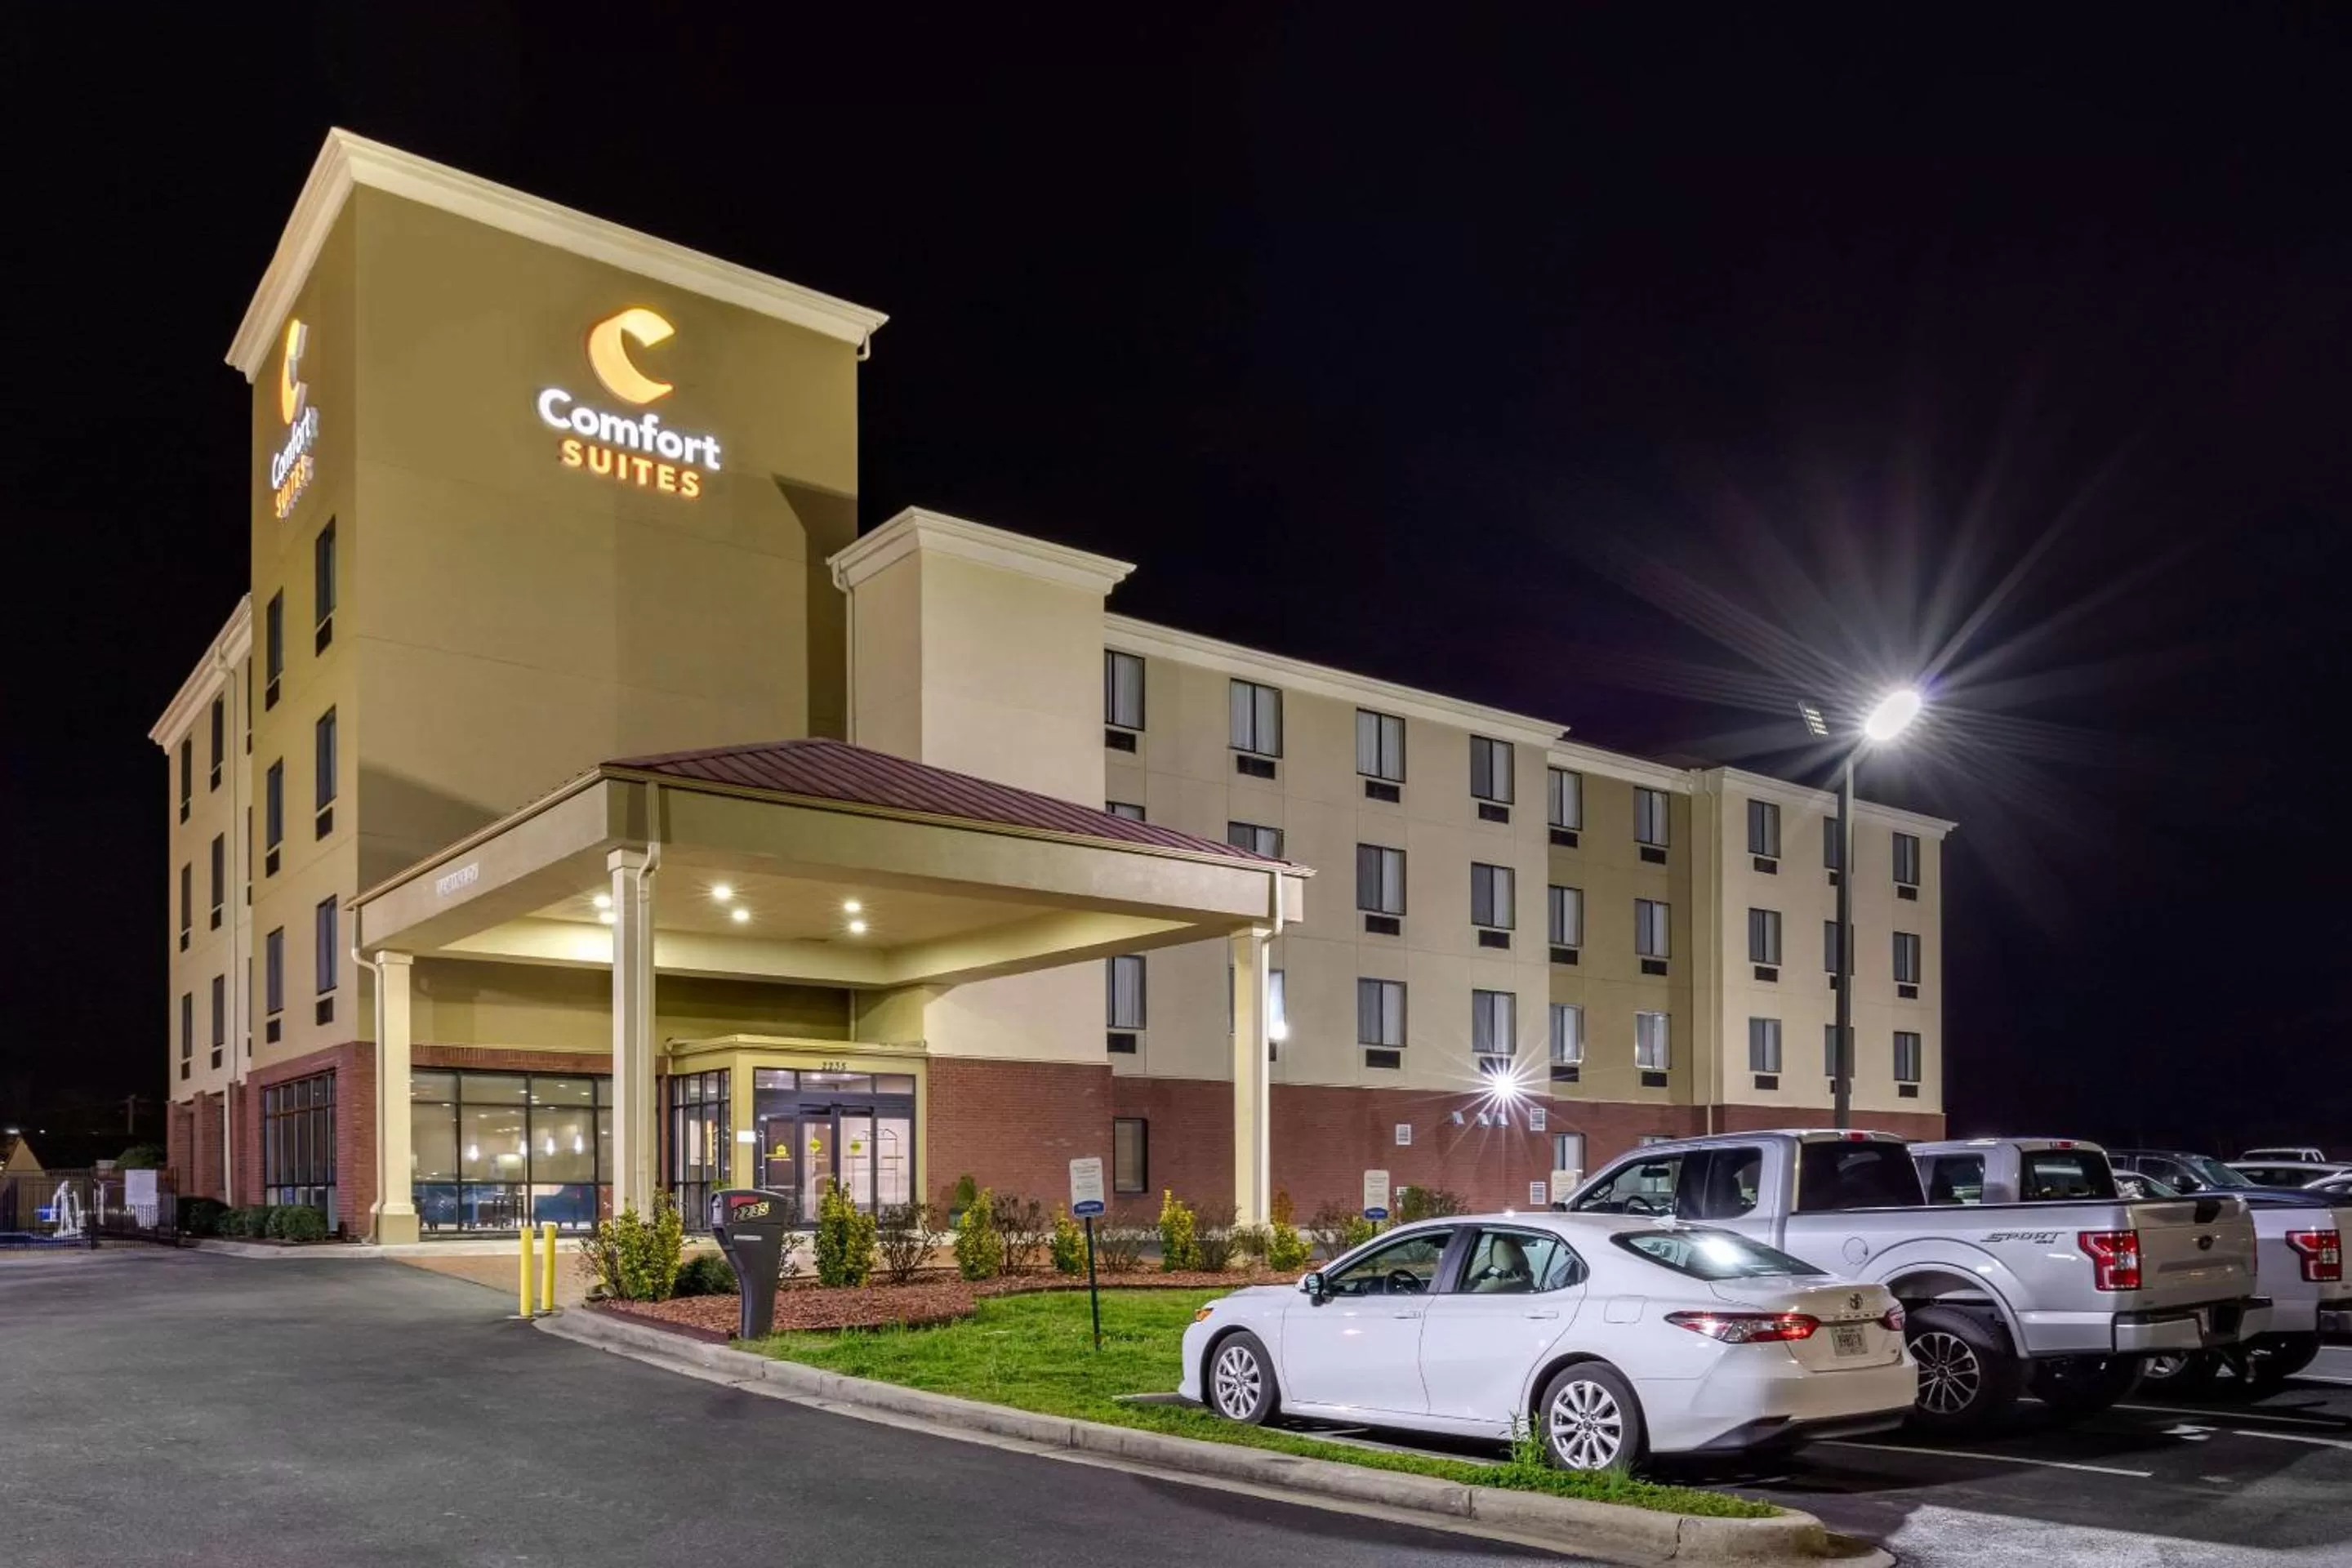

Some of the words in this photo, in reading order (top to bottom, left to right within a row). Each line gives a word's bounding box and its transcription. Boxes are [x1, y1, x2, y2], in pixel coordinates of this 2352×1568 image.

[272, 407, 310, 489] Comfort
[538, 388, 721, 471] Comfort
[562, 439, 700, 497] SUITES
[1980, 1232, 2065, 1243] SPORT
